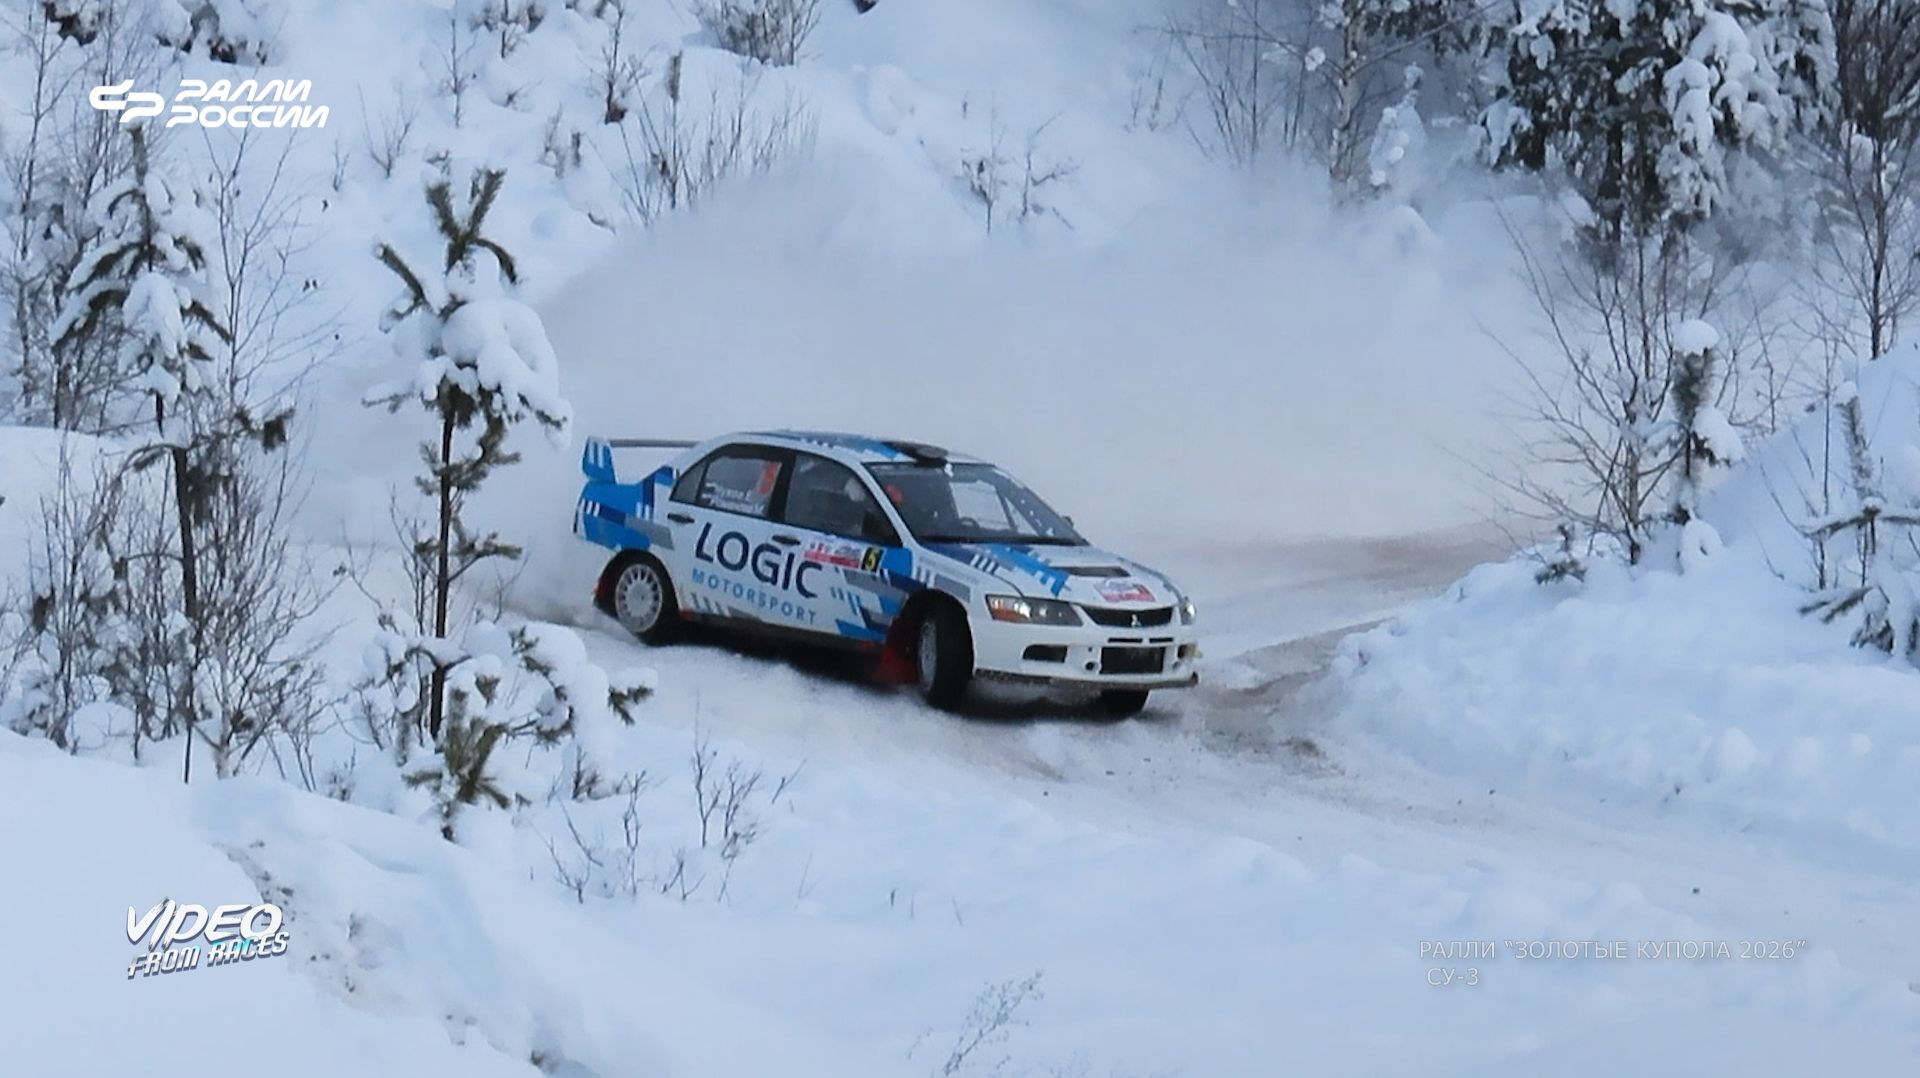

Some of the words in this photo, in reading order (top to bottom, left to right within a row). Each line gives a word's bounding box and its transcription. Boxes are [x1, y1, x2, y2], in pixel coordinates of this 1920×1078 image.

[694, 522, 824, 598] LOGIC
[864, 549, 882, 572] 5
[691, 568, 818, 625] MOTORSPORT
